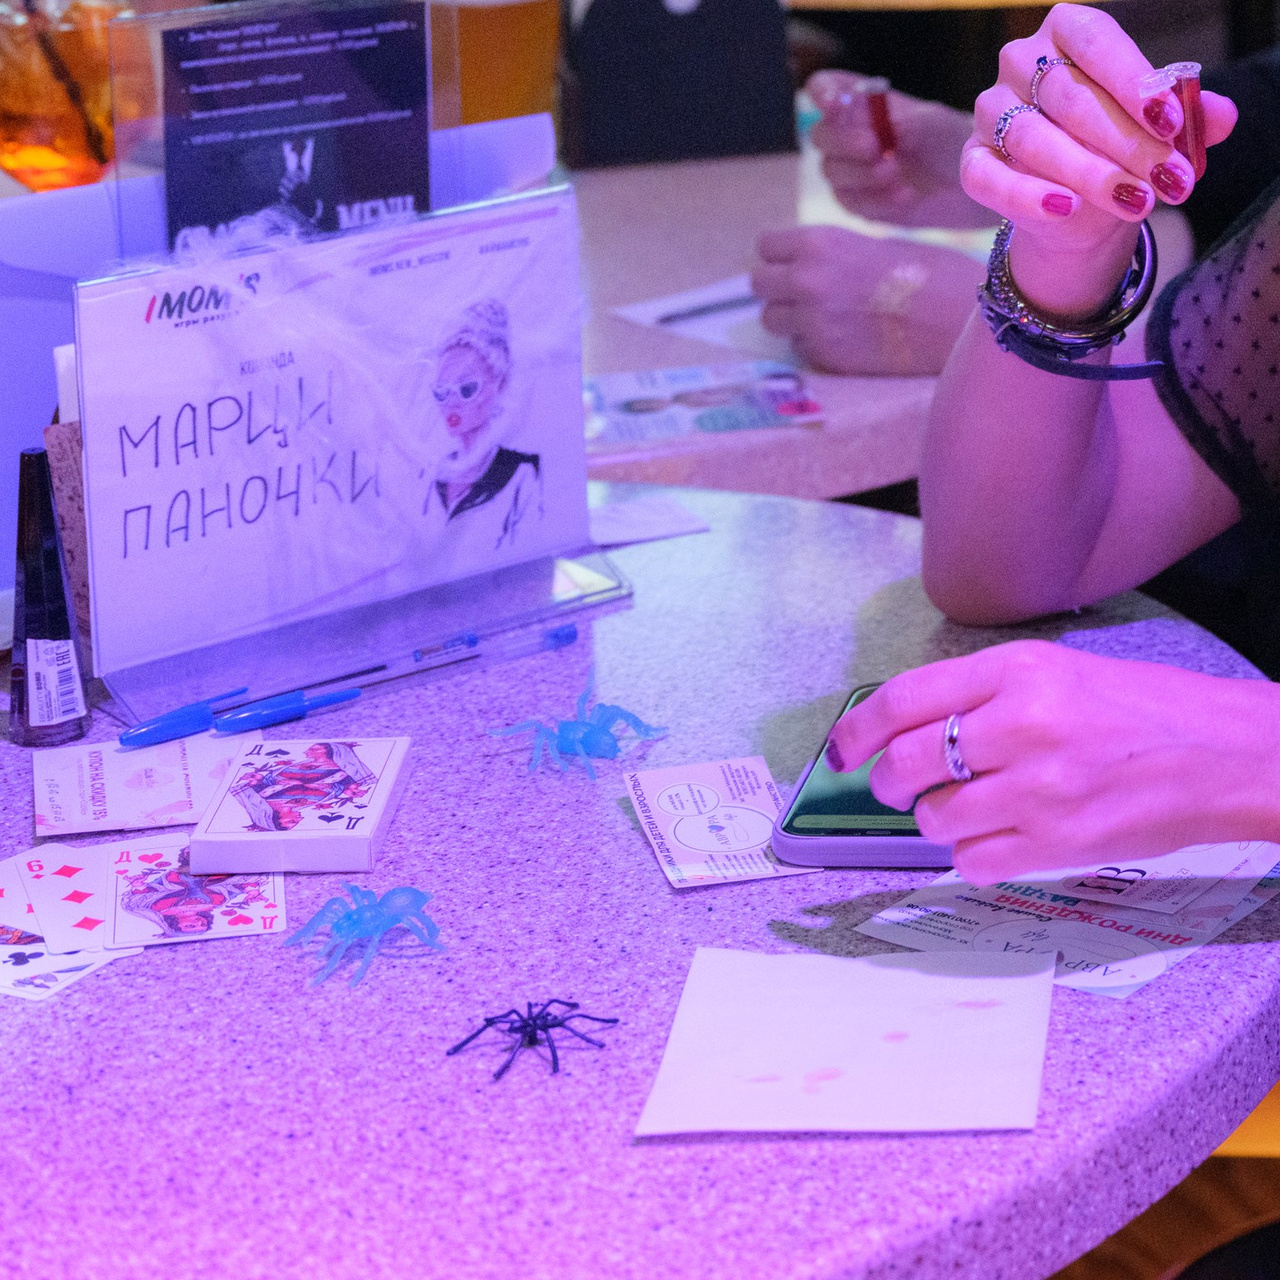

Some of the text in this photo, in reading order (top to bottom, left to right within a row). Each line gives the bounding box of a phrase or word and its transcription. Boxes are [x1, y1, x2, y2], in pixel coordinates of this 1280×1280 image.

[119, 371, 333, 478] МАРЦИ
[123, 450, 381, 559] ПАНОЧКИ
[88, 782, 106, 807] СКИДКУ
[628, 773, 652, 814] ВЗРОСЛЫХ
[26, 859, 44, 873] 6
[993, 894, 1134, 933] РОЖДЕНИЯ
[1135, 928, 1193, 946] ДНИ
